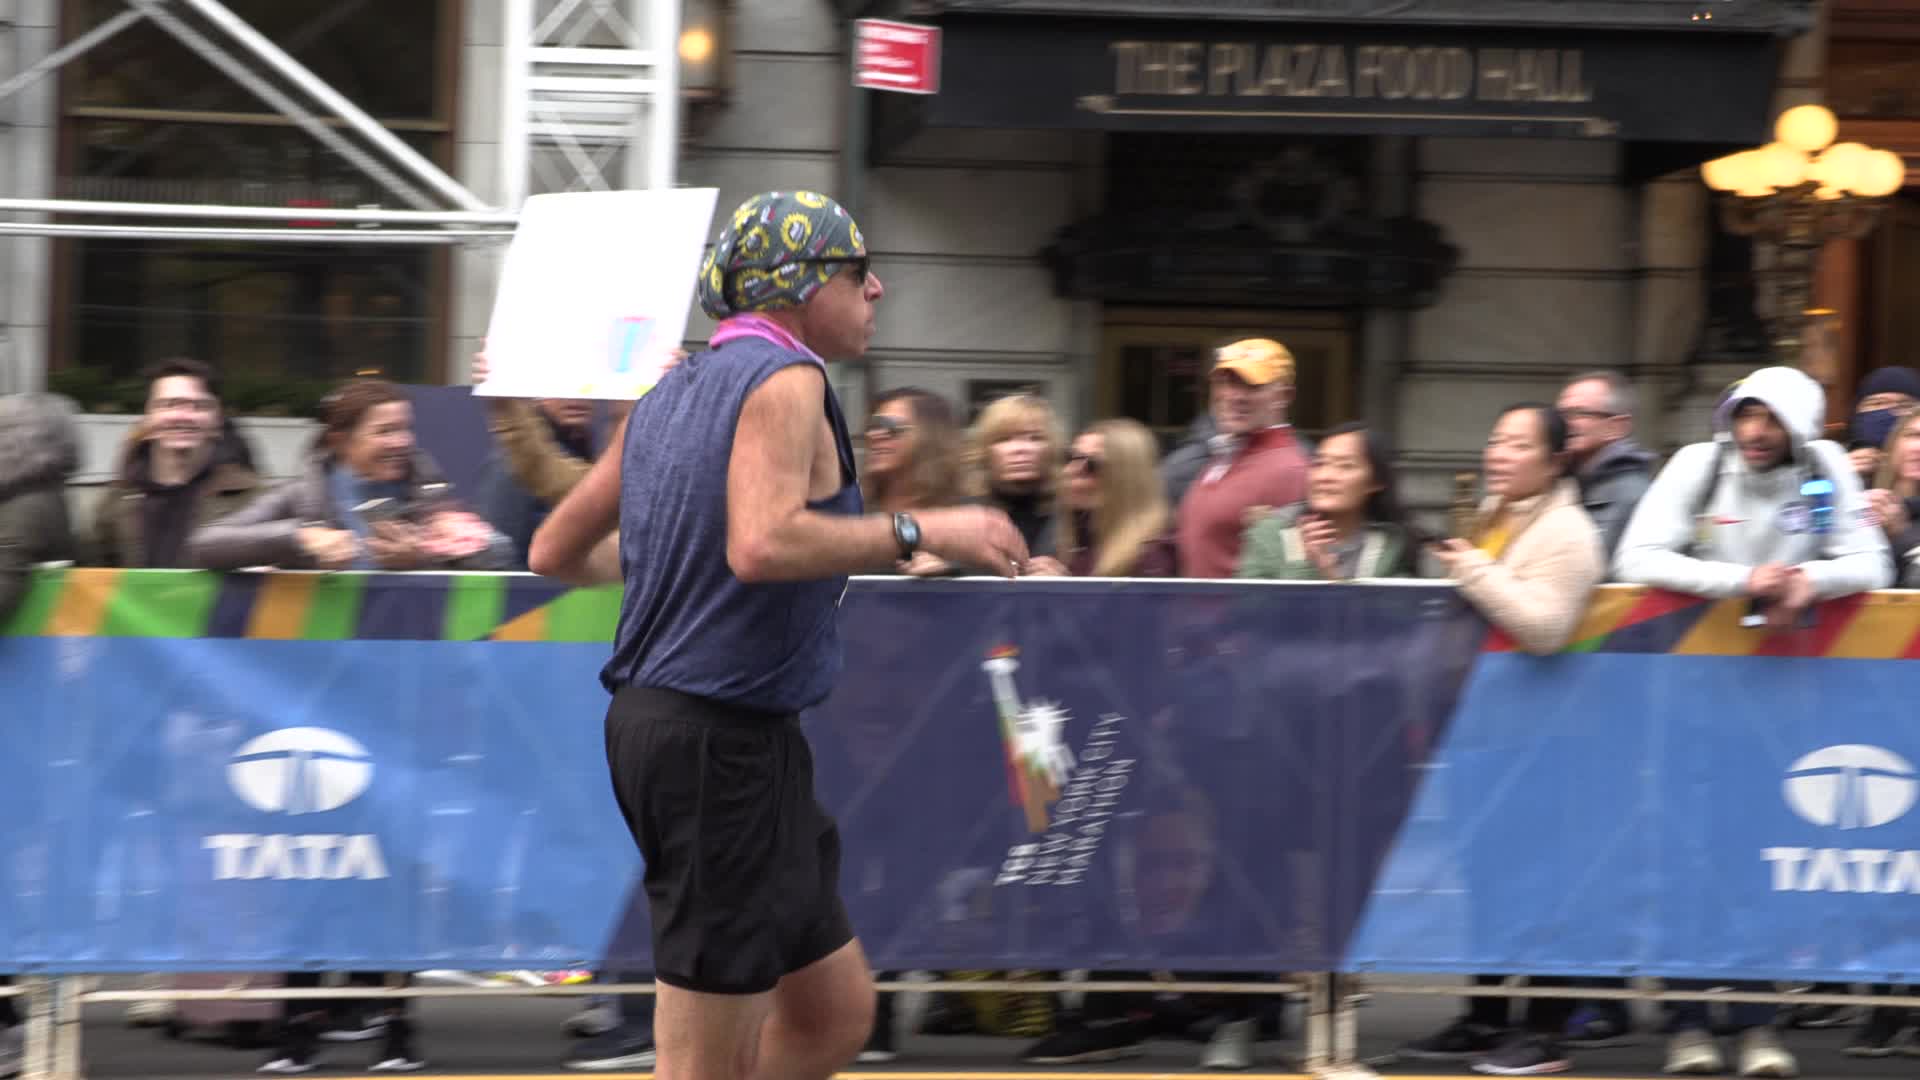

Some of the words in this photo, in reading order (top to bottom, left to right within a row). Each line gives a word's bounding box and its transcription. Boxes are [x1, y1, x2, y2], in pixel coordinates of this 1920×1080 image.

[1110, 42, 1201, 94] THE
[1206, 44, 1350, 97] PLAZA
[1353, 46, 1472, 99] FOOD
[1475, 49, 1593, 102] HALL
[203, 833, 391, 880] TATA
[1024, 832, 1072, 885] NEW
[1048, 766, 1104, 827] YORK
[1052, 759, 1136, 885] MARATHON
